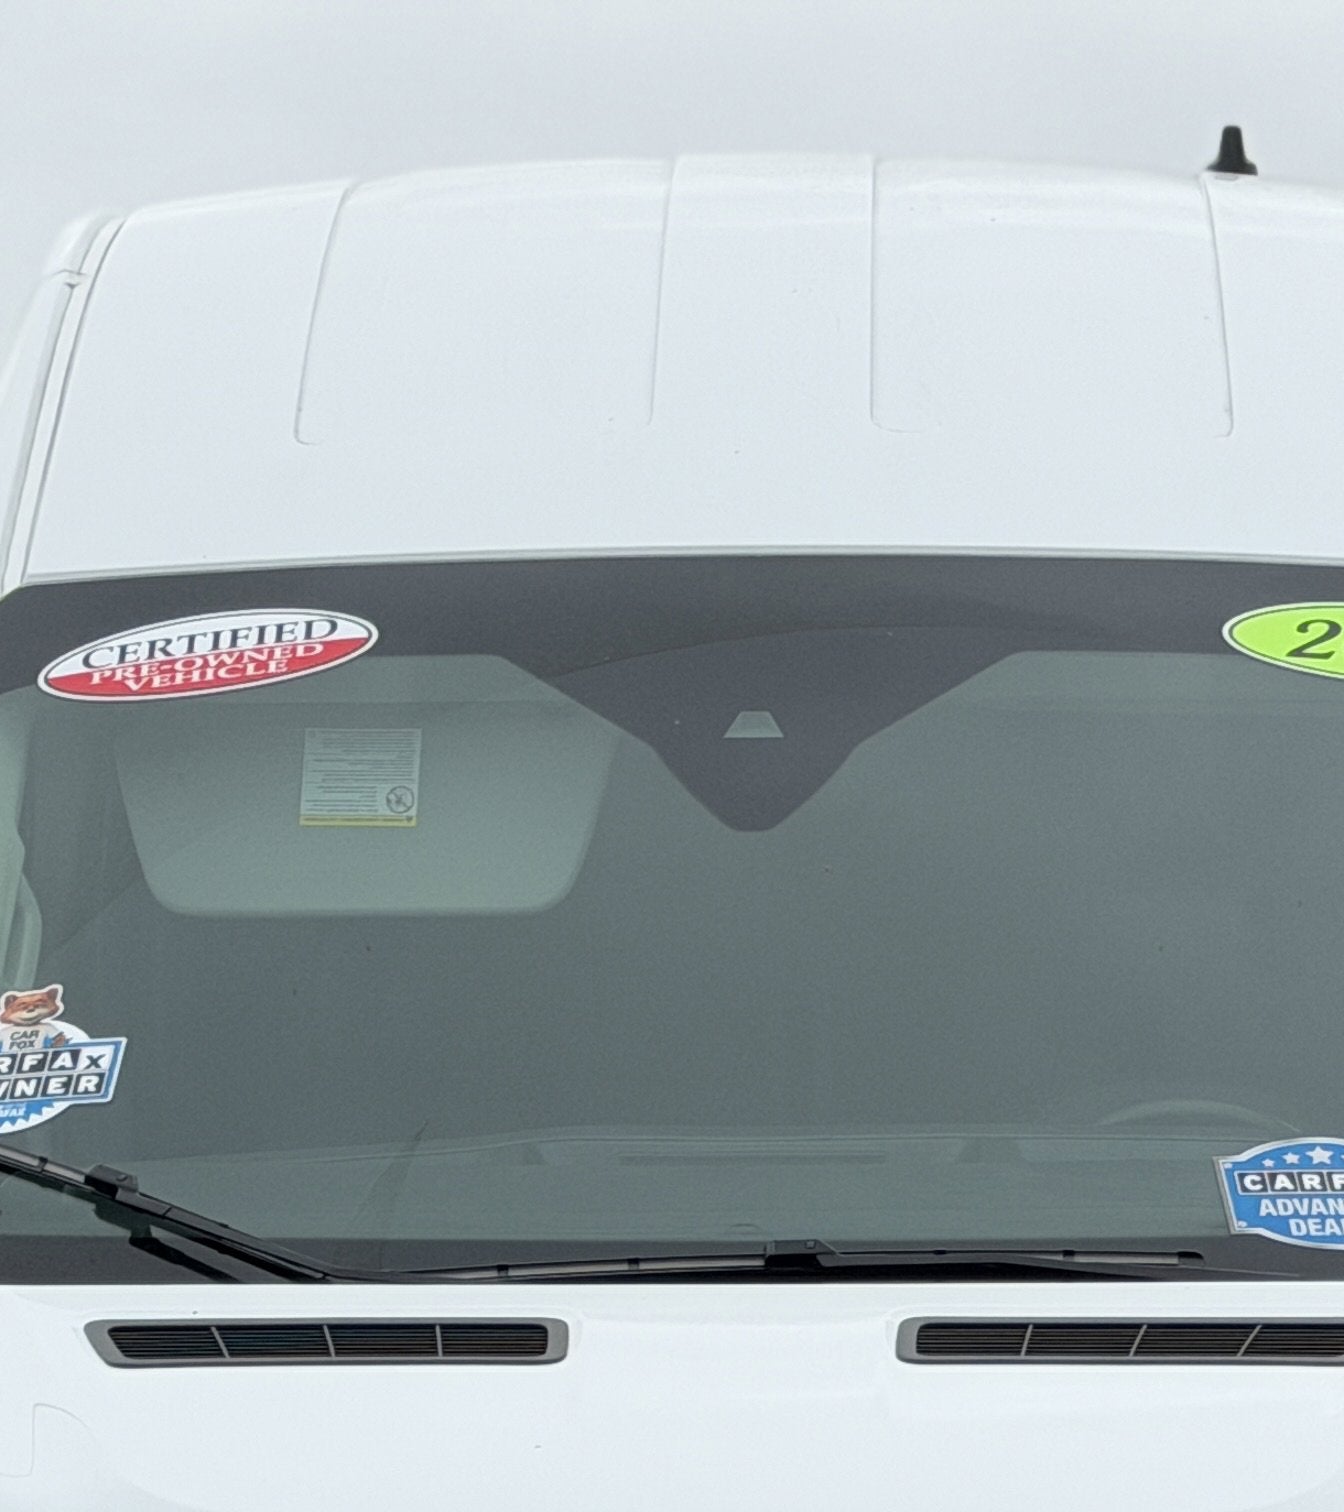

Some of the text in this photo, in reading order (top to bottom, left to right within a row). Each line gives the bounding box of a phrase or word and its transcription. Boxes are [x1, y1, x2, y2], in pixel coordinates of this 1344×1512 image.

[82, 619, 338, 670] CERTIFIED
[90, 643, 325, 685] PRE-OWNED
[124, 659, 288, 692] VEHICLE
[9, 1039, 36, 1051] FOX
[10, 1029, 41, 1041] CAR
